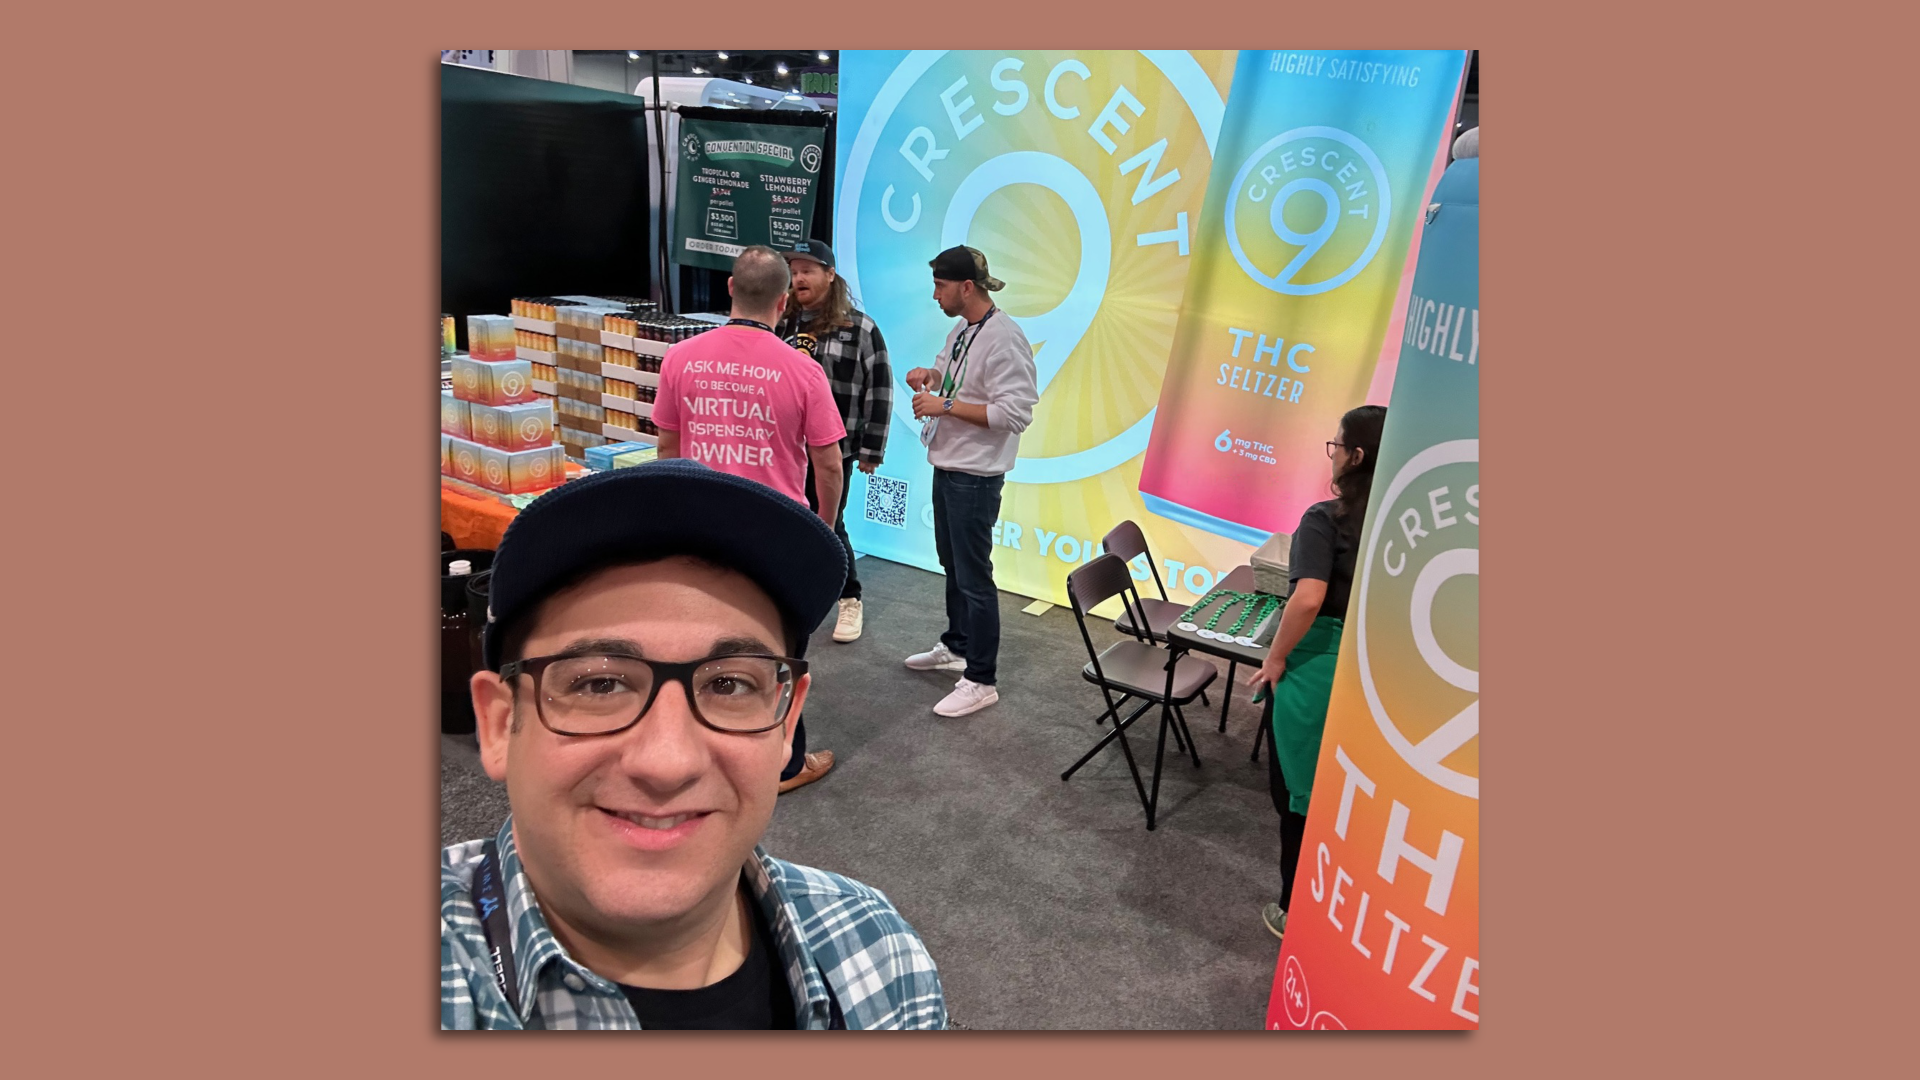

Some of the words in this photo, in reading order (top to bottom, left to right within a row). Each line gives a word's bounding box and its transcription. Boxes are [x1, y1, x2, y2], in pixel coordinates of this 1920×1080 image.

[1269, 52, 1326, 77] HIGHLY
[1327, 58, 1421, 88] SATISFYING
[704, 140, 756, 154] CONVENTION
[757, 141, 795, 161] SPECIAL
[806, 152, 818, 172] 9
[881, 57, 1190, 256] CRESCENT
[692, 175, 716, 185] GINGER
[716, 178, 750, 189] LEMONADE
[701, 167, 730, 178] TROPICAL
[730, 171, 740, 179] OR
[759, 174, 812, 187] STRAWBERRY
[1248, 147, 1369, 220] CRESCENT
[764, 183, 808, 195] LEMONADE
[782, 208, 801, 216] pallet
[772, 221, 800, 232] $5,900
[1269, 177, 1341, 285] 9
[688, 241, 714, 251] ORDER
[715, 245, 740, 255] TODAY
[941, 151, 1111, 402] 9
[1404, 294, 1479, 365] HIGHLY
[1228, 326, 1316, 374] THC
[683, 360, 714, 374] ASK
[716, 361, 740, 376] ME
[742, 364, 782, 383] HOW
[1216, 363, 1305, 404] SELTZER
[694, 379, 708, 389] TO
[710, 380, 755, 394] BECOME
[757, 386, 765, 397] A
[683, 397, 776, 425] VIRTUAL
[690, 440, 774, 467] OWNER
[1214, 428, 1233, 452] 6
[1234, 438, 1251, 449] mg
[1253, 441, 1274, 454] THC
[1245, 452, 1258, 461] mg
[1259, 455, 1277, 465] CBD
[1164, 558, 1229, 596] TO
[1311, 842, 1479, 1024] SELTZE
